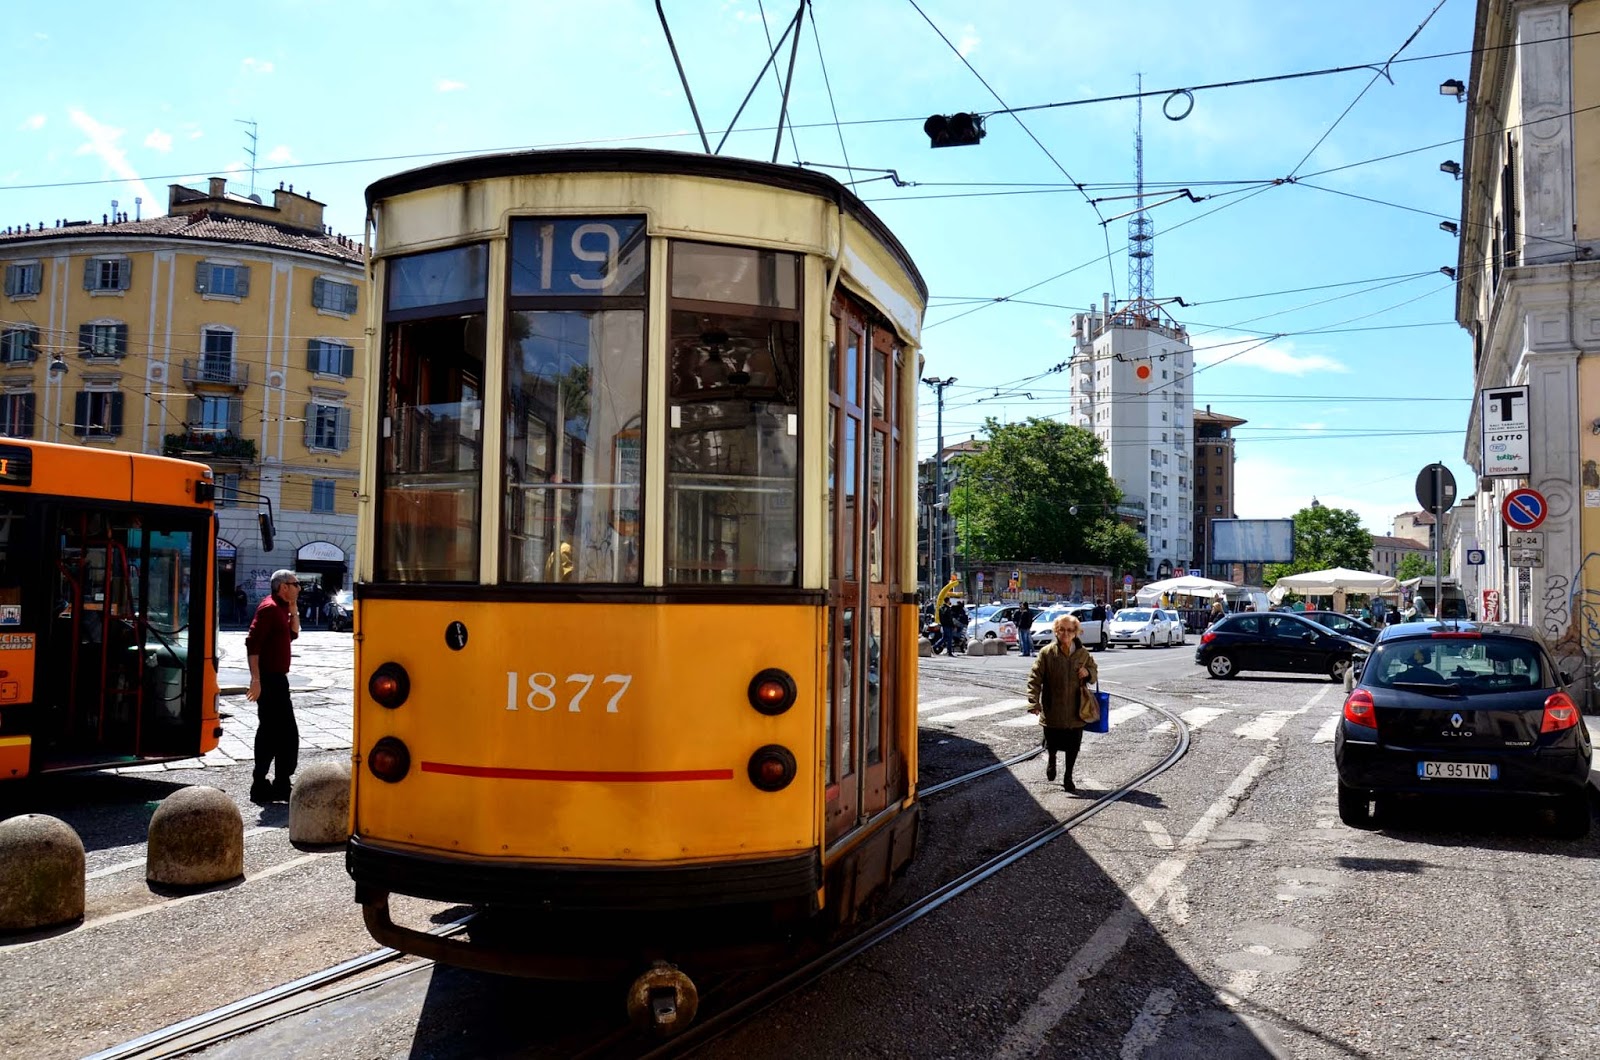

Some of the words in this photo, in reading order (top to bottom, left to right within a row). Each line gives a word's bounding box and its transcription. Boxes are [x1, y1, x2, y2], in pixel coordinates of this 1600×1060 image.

[538, 223, 620, 290] 19
[1489, 391, 1523, 421] T
[0, 634, 33, 643] Class
[505, 671, 632, 713] 1877
[1425, 763, 1442, 776] CX
[1446, 764, 1490, 778] 951VN
